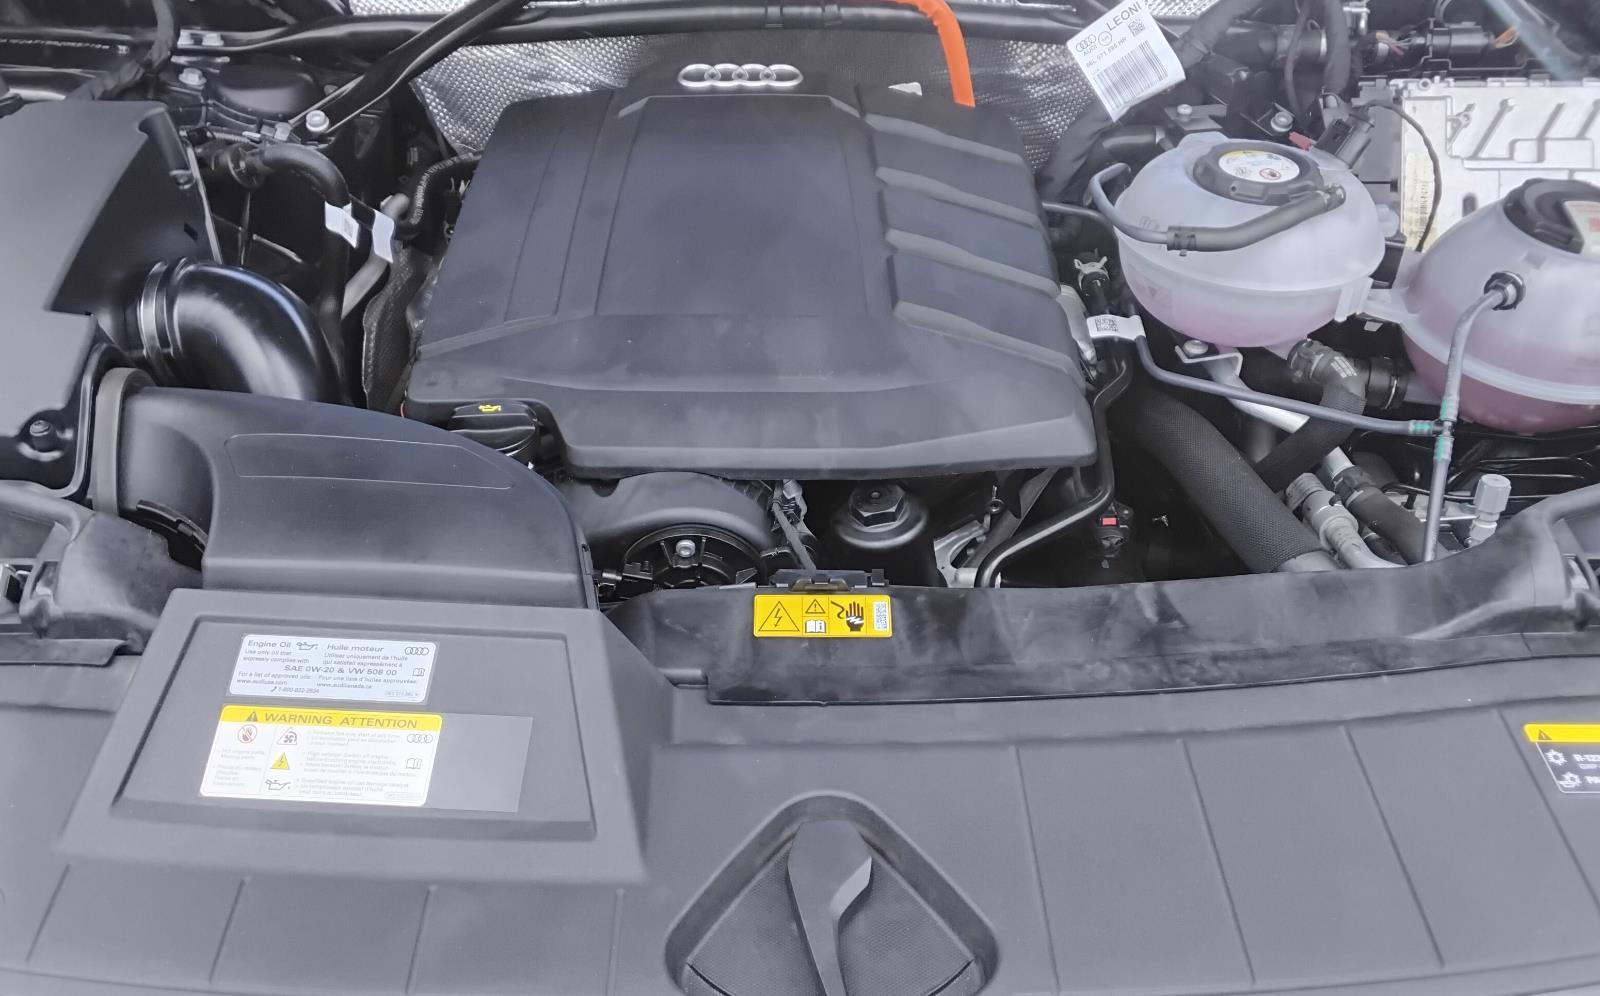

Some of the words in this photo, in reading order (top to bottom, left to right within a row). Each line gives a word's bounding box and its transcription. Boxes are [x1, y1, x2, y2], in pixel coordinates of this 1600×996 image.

[1106, 1, 1142, 31] LEONI
[248, 640, 277, 648] Engine
[265, 712, 333, 725] WARNING
[340, 716, 418, 729] ATTENTION
